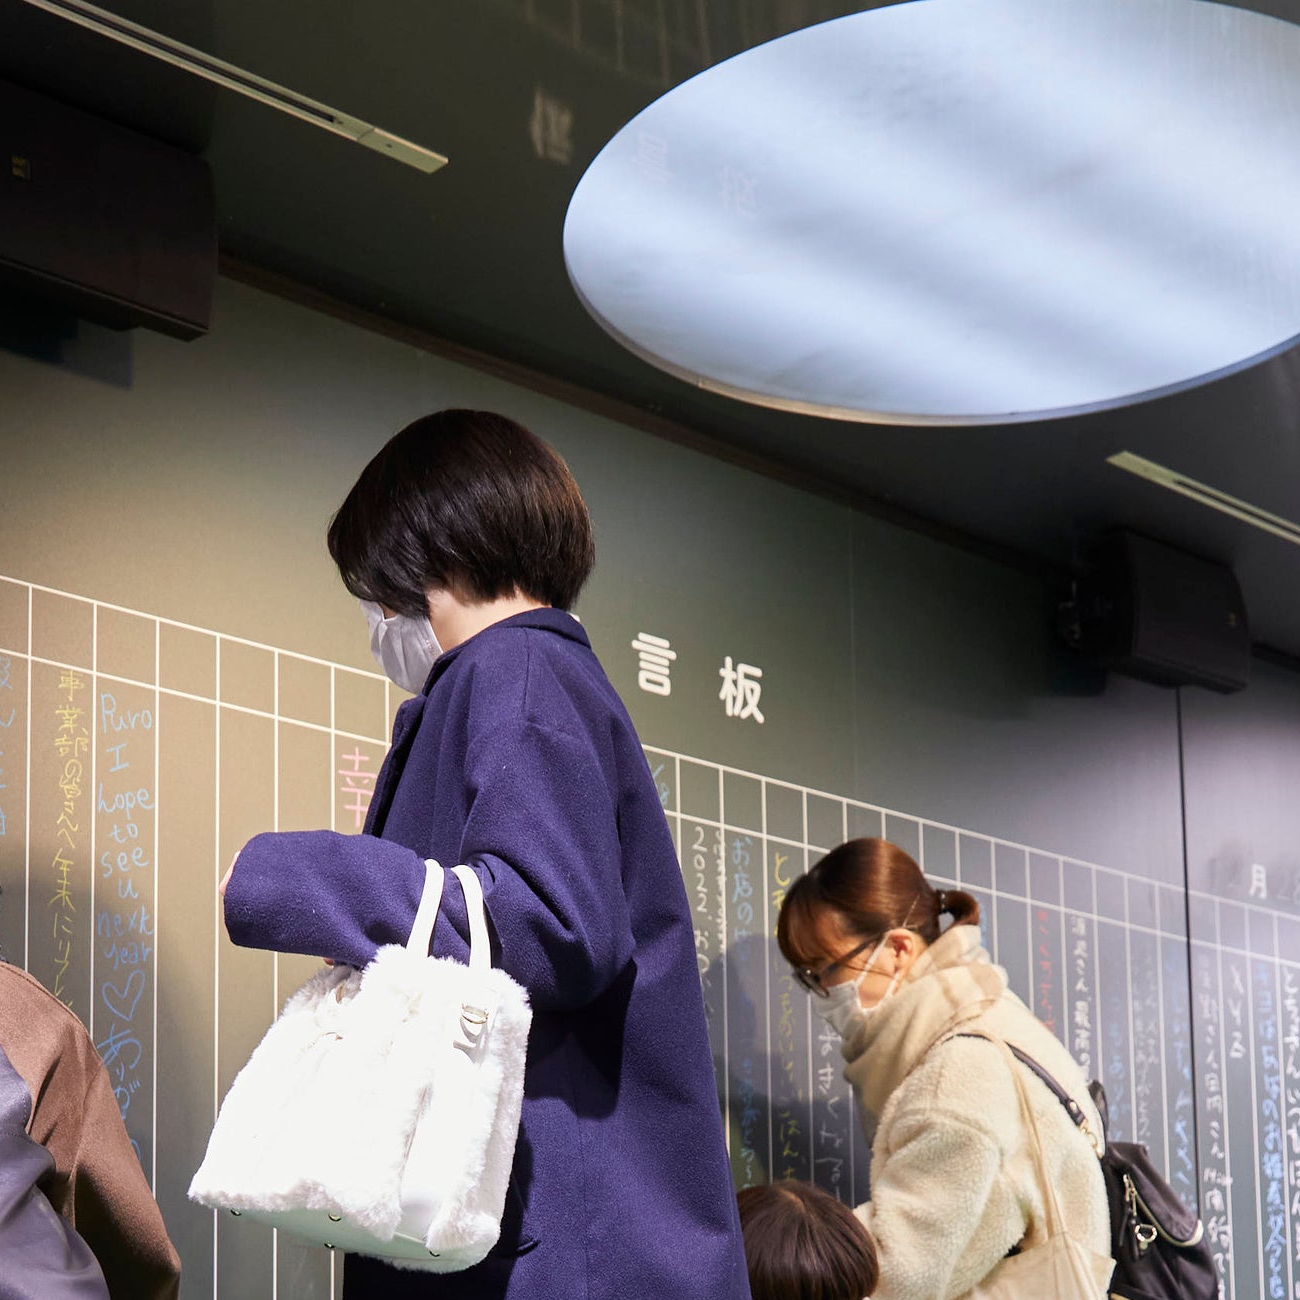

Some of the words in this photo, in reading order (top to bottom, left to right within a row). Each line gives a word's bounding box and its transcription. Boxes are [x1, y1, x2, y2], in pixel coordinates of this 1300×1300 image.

[98, 784, 154, 817] hope
[109, 821, 139, 844] to
[102, 847, 150, 879] see
[97, 906, 155, 937] next
[104, 944, 152, 971] year
